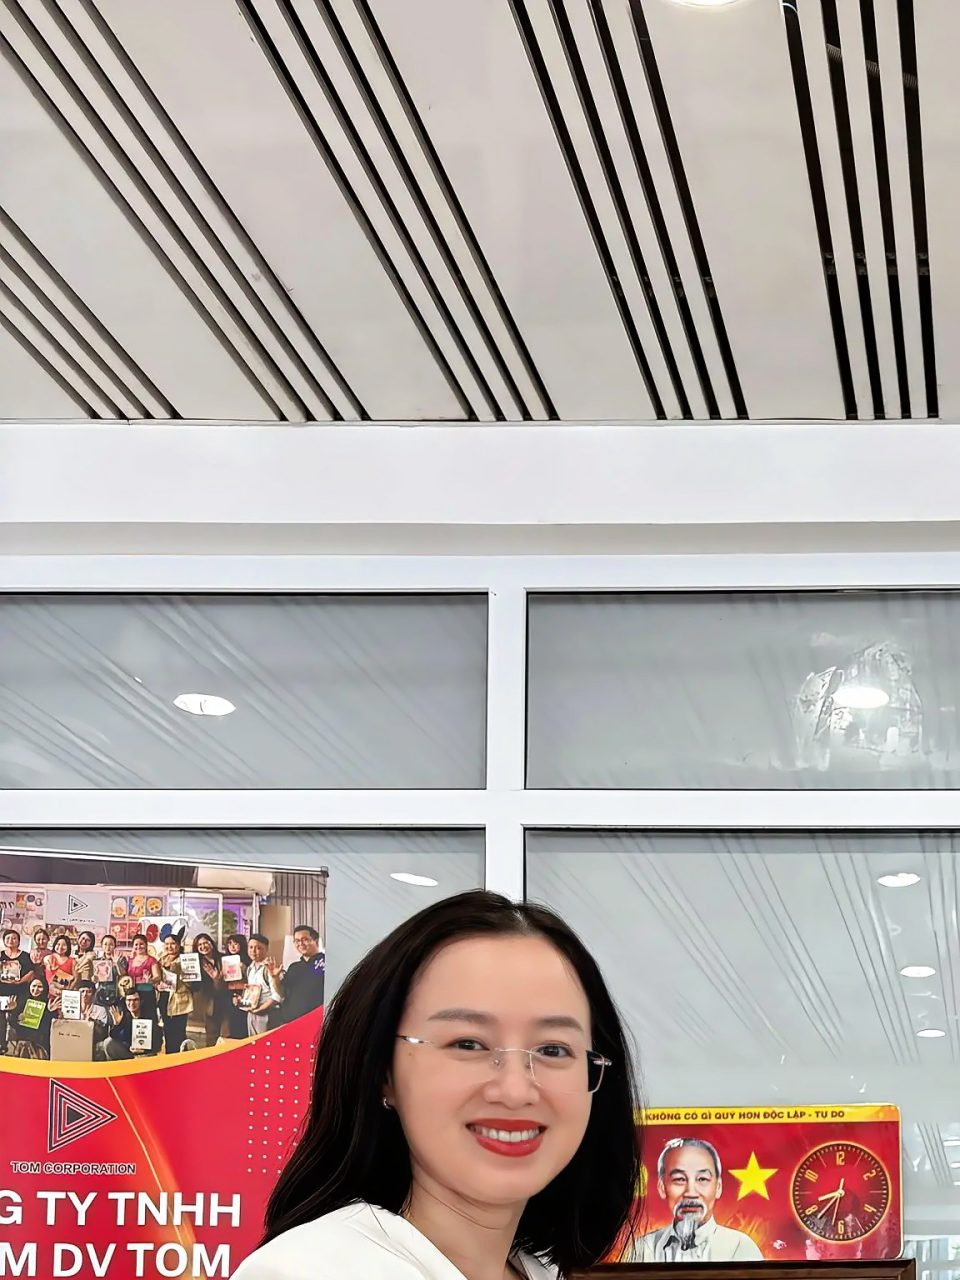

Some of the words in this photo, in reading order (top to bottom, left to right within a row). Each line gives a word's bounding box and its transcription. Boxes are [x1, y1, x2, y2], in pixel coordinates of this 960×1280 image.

[831, 1110, 845, 1119] DO
[836, 1151, 845, 1166] 12
[10, 1161, 41, 1174] TOM
[44, 1162, 137, 1175] CORPORATION
[862, 1169, 877, 1181] 2
[36, 1191, 98, 1226] TY
[107, 1191, 242, 1228] TNHH
[804, 1204, 819, 1216] 8
[863, 1203, 878, 1213] 4
[837, 1220, 845, 1234] 6
[53, 1242, 117, 1278] DV
[126, 1242, 231, 1278] TOM
